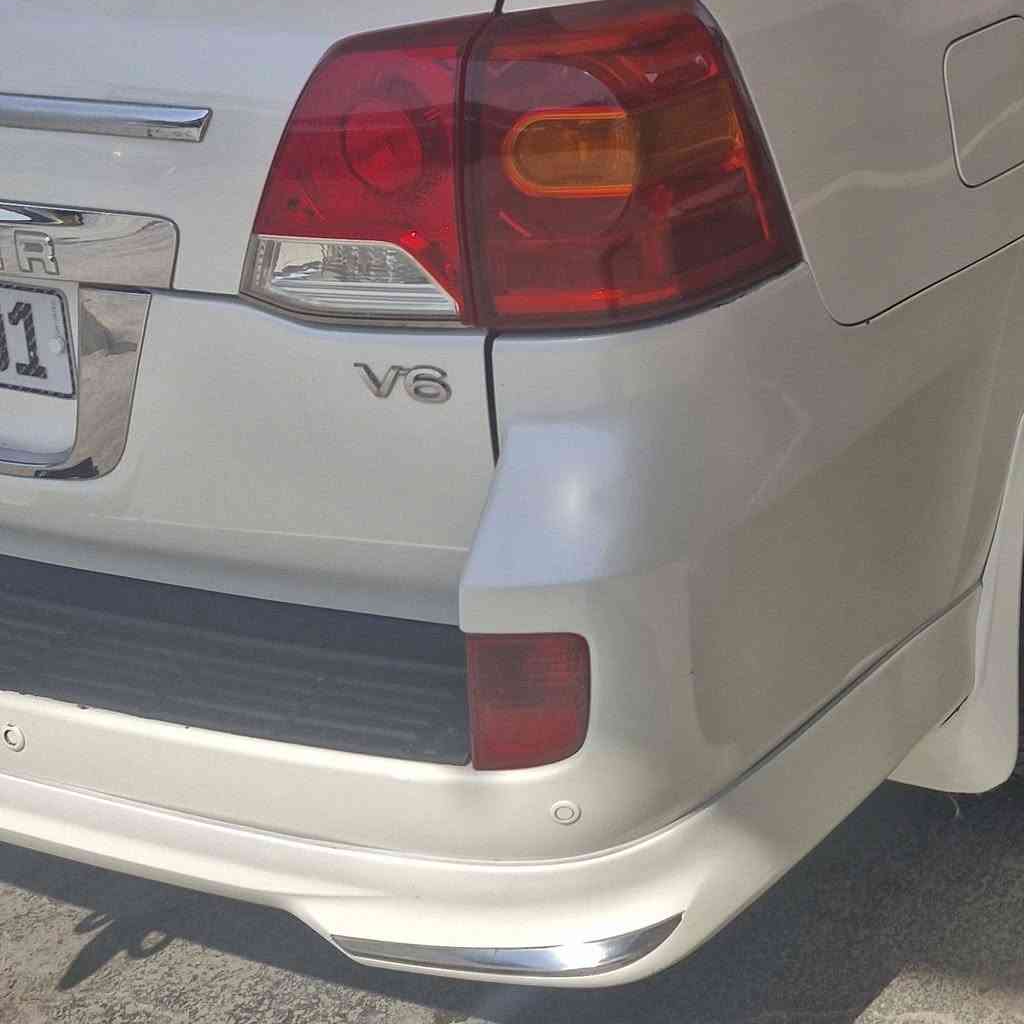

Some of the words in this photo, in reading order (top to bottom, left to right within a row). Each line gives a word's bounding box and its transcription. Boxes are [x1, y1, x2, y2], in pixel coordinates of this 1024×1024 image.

[0, 228, 60, 276] R
[0, 301, 48, 379] 1
[353, 362, 452, 404] V6
